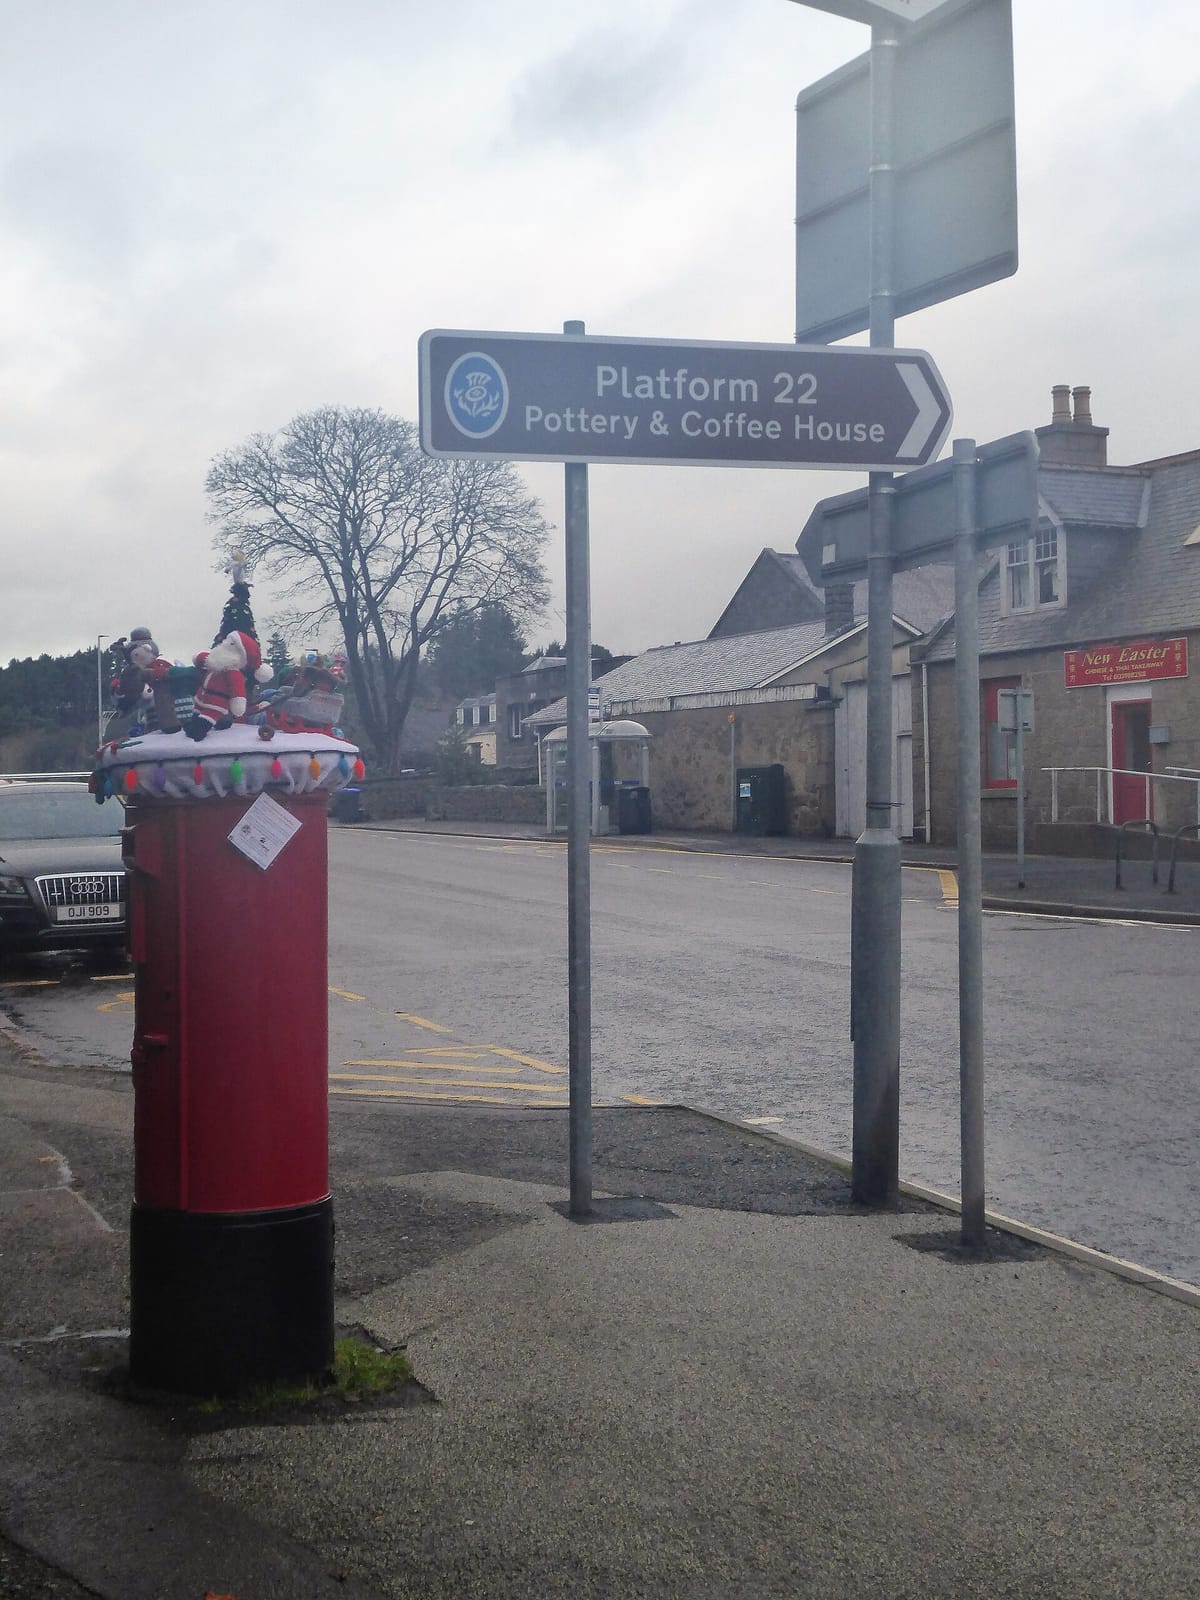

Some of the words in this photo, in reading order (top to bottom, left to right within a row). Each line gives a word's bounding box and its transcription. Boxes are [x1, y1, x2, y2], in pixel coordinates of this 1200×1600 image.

[596, 365, 759, 402] Platform
[773, 372, 818, 404] 22
[524, 404, 639, 440] Pottery
[649, 410, 669, 436] &
[681, 411, 782, 440] Coffee
[794, 415, 886, 443] House
[1081, 652, 1112, 667] New
[1118, 646, 1170, 663] Easter
[88, 905, 110, 916] 909
